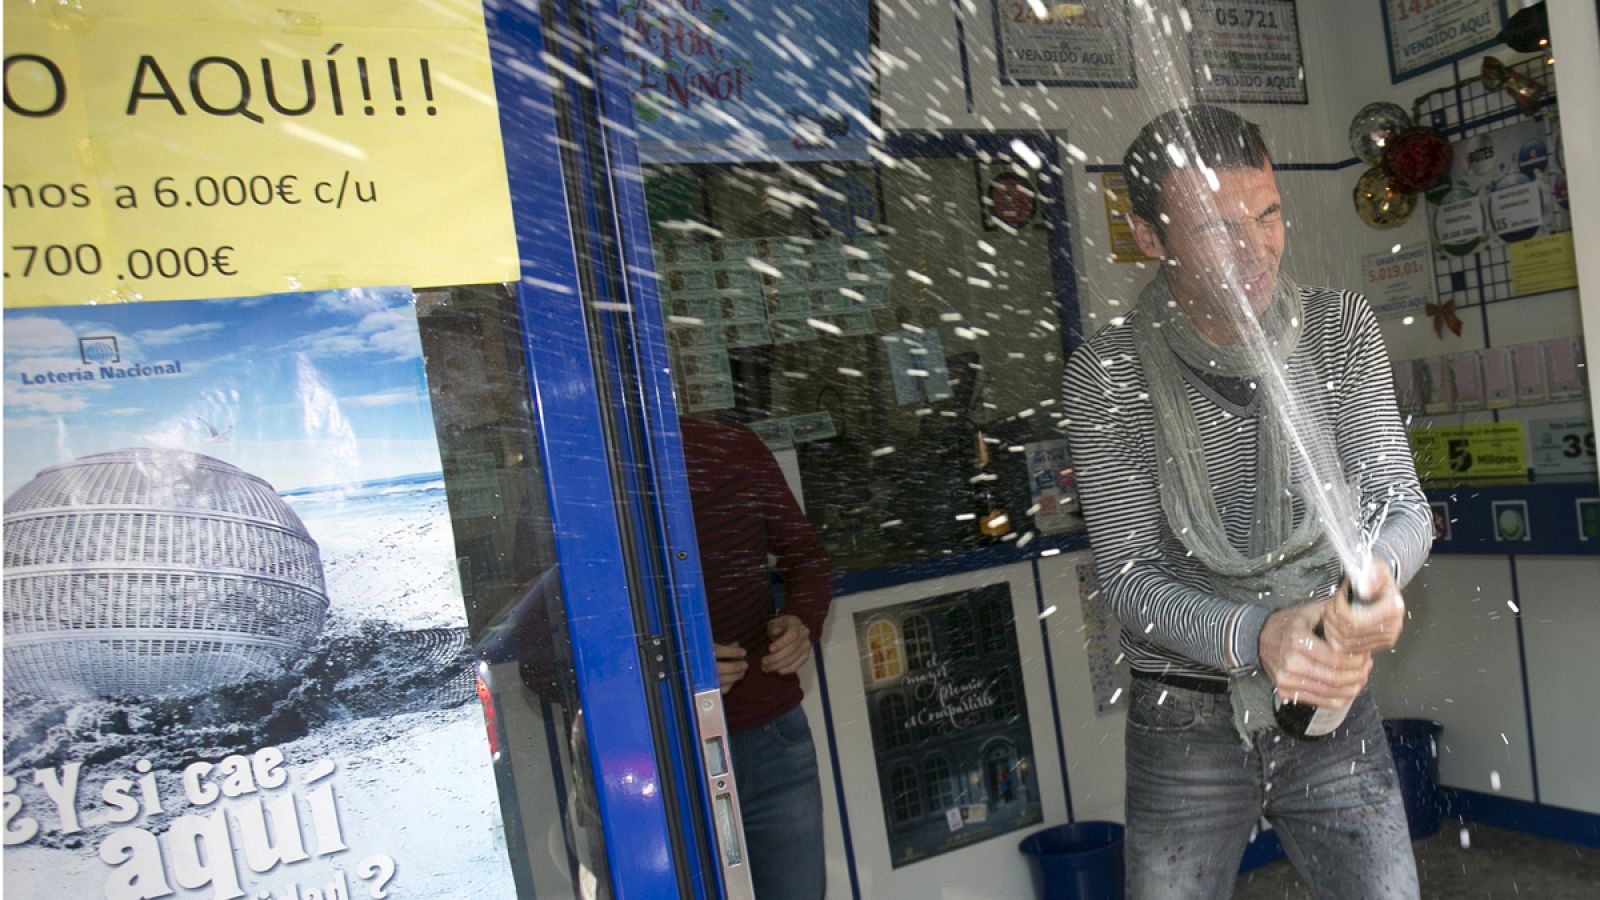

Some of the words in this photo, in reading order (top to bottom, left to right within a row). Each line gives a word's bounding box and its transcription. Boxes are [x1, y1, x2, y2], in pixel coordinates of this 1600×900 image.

[1215, 7, 1279, 29] 05.721
[1018, 48, 1078, 64] VENDIDO
[1402, 26, 1457, 57] VENDIDO
[3, 54, 68, 118] O
[126, 43, 437, 124] AQUÍ!!!
[3, 183, 91, 209] mos
[114, 184, 138, 209] a
[154, 175, 302, 208] 6.000€
[314, 170, 378, 209] c/u
[117, 245, 239, 280] .000€
[100, 360, 183, 380] Nacional
[1447, 437, 1474, 473] 5
[103, 759, 164, 824] si
[183, 746, 289, 805] cae
[99, 759, 350, 900] aquí
